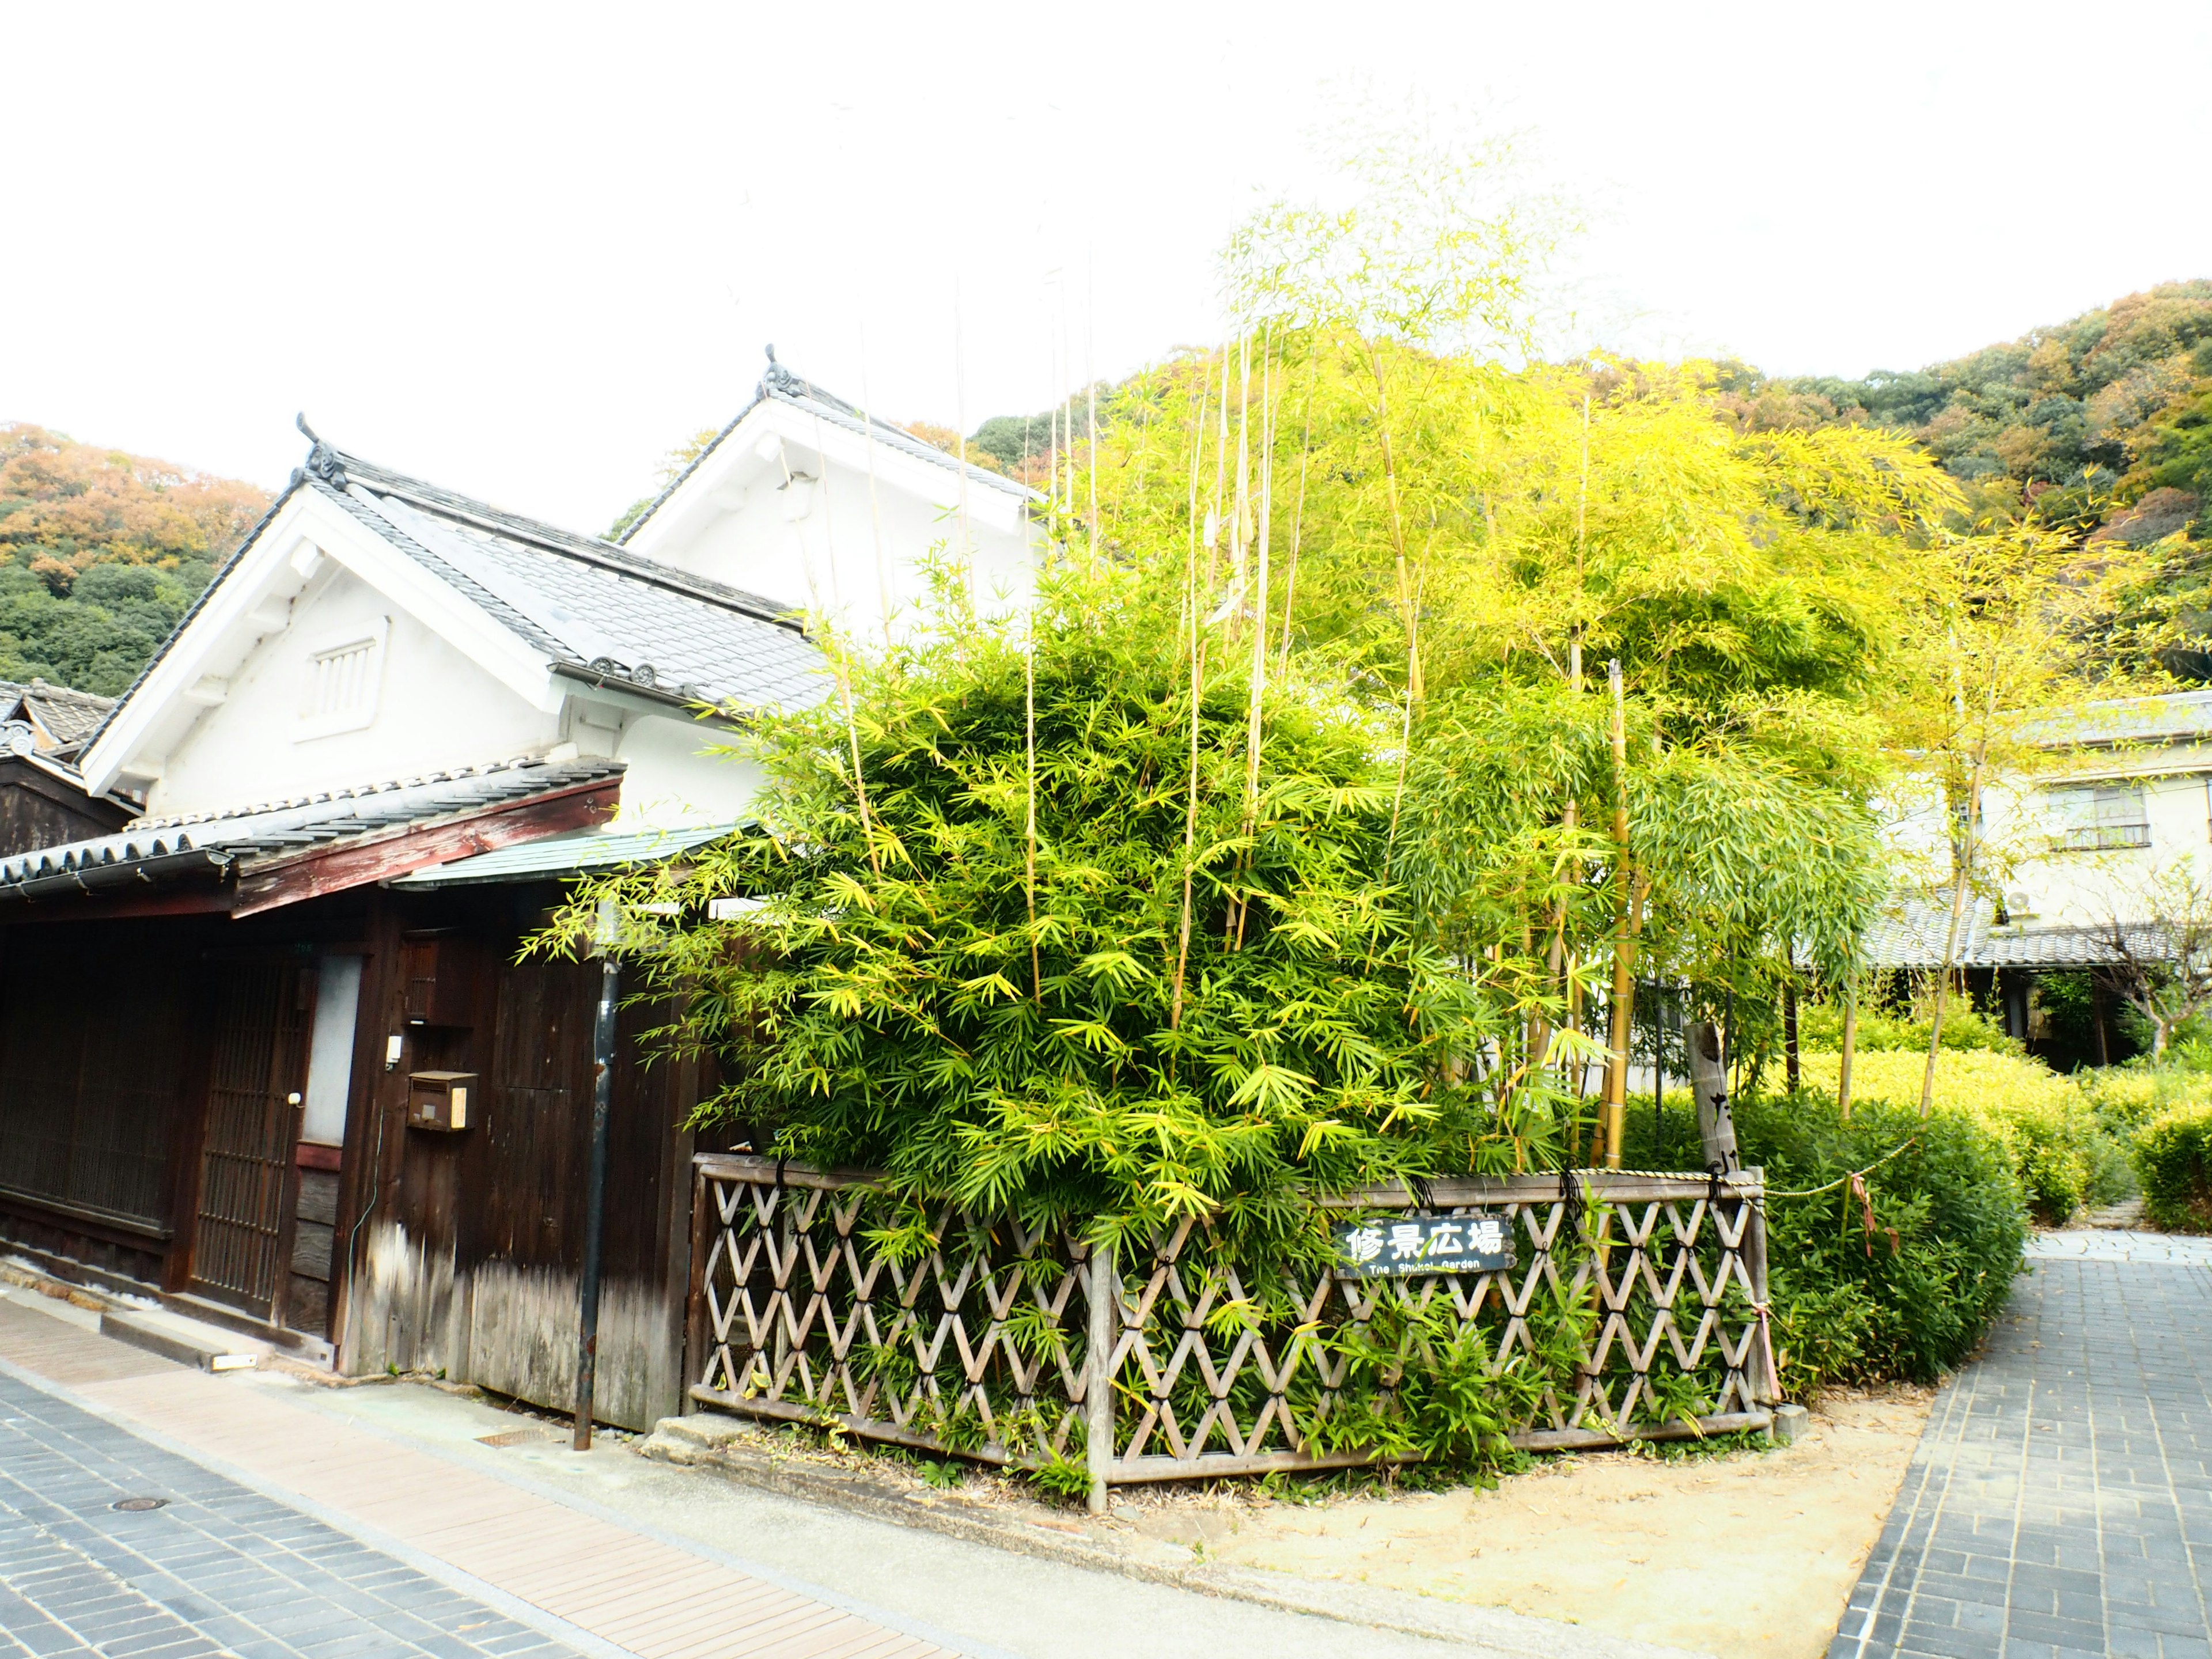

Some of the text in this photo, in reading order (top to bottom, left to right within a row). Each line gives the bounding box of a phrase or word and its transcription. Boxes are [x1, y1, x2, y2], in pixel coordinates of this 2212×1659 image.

[1346, 1221, 1503, 1261] 修景広場
[1369, 1265, 1389, 1275] The
[1441, 1259, 1479, 1270] Garden
